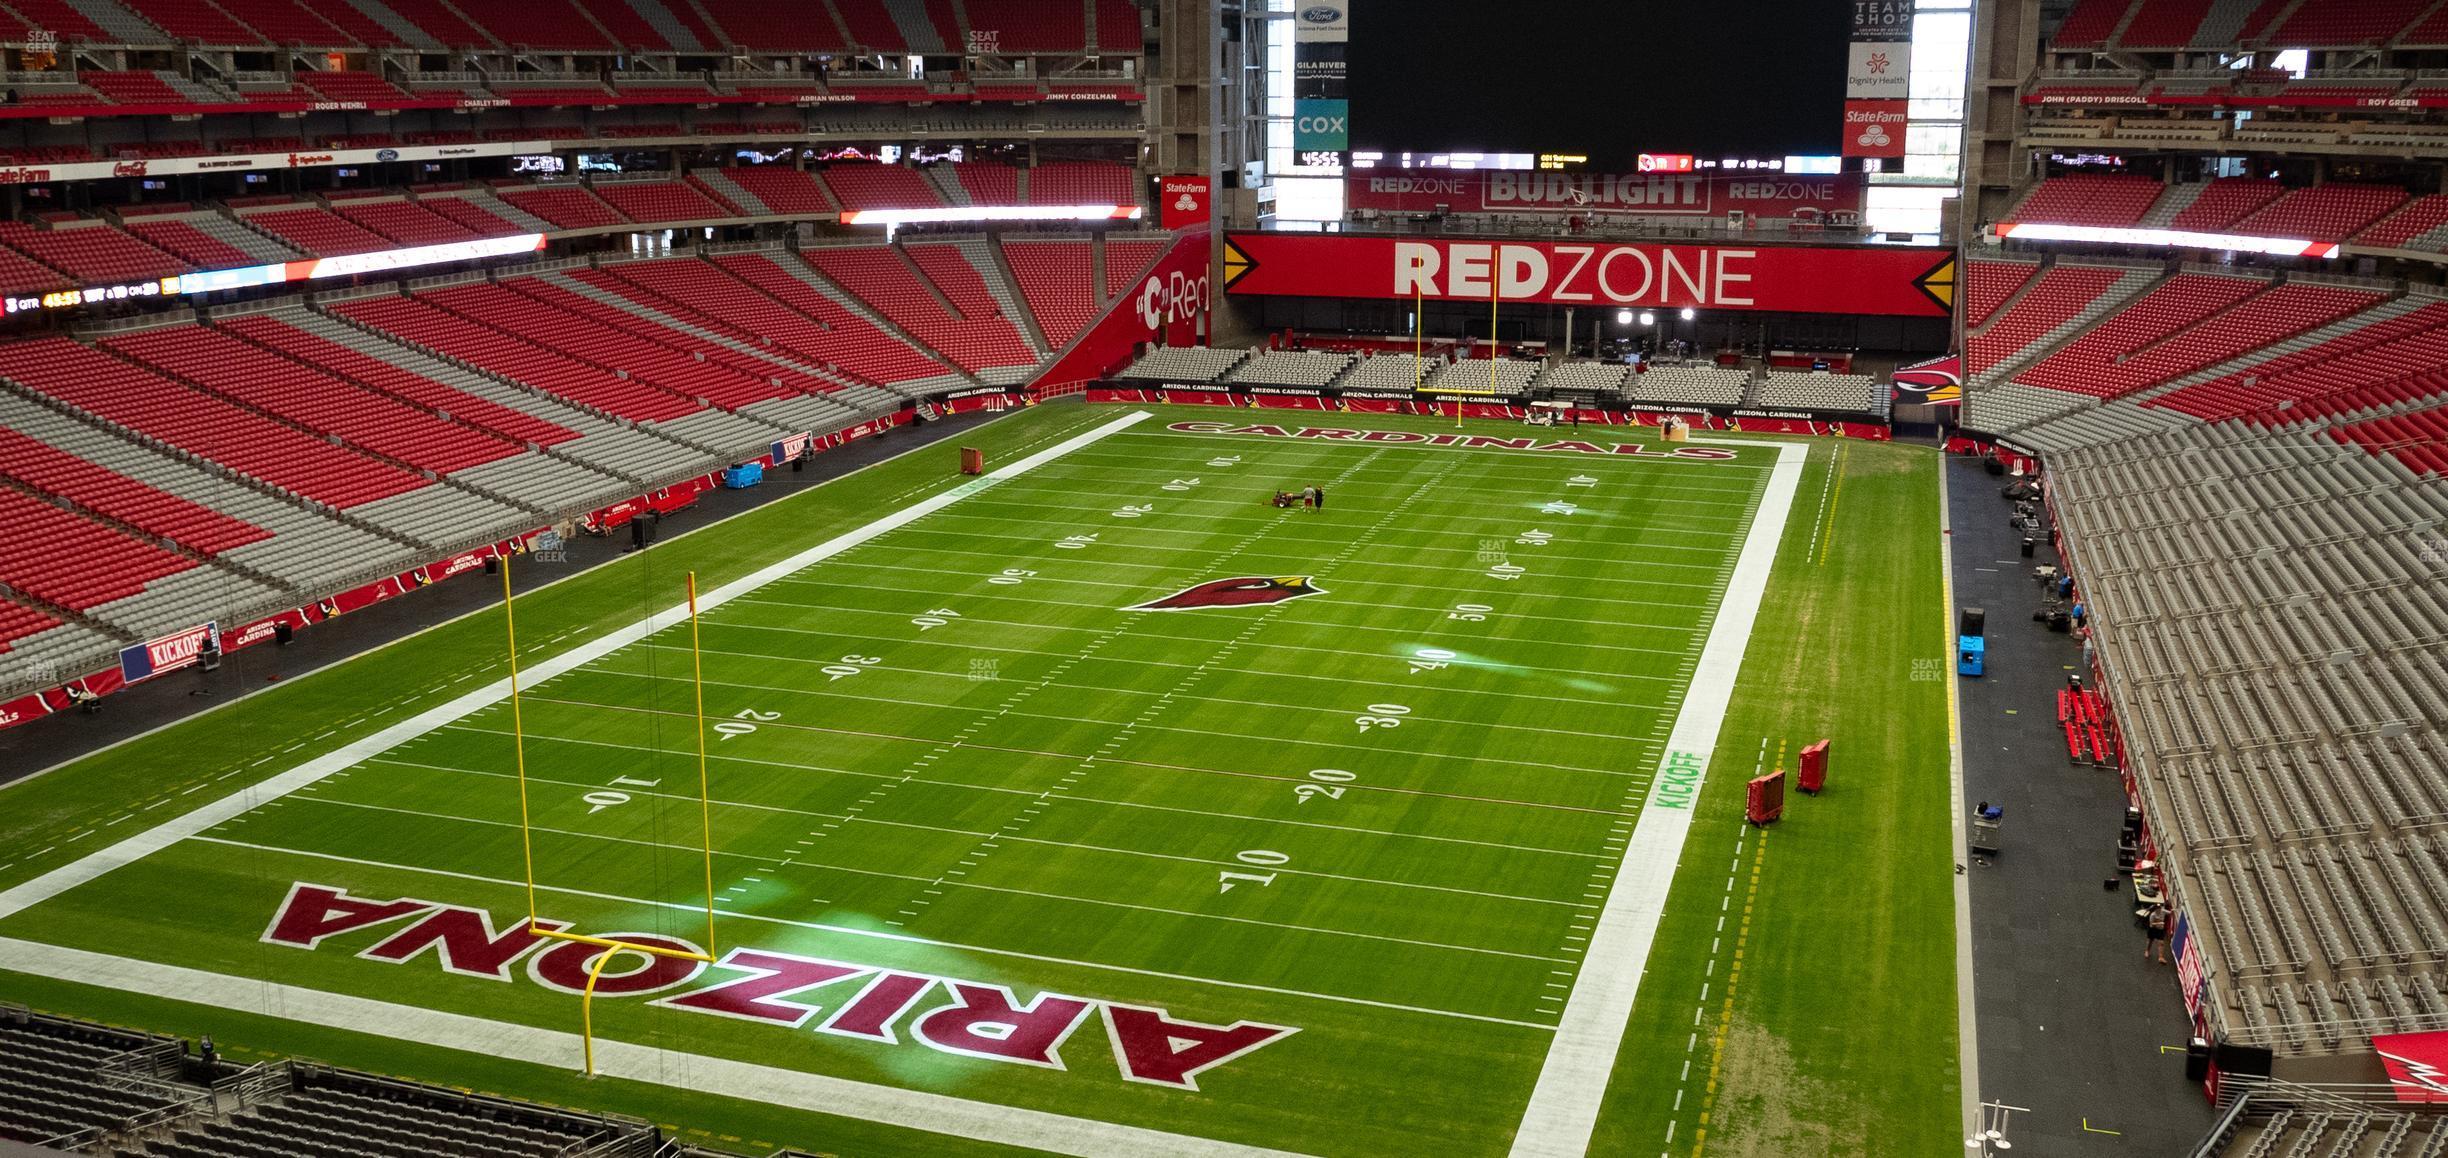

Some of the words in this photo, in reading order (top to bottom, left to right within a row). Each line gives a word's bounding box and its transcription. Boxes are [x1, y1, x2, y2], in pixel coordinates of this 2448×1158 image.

[1855, 2, 1910, 13] TEAM
[1855, 14, 1909, 25] SHOP
[1849, 76, 1877, 87] Dignity
[1878, 77, 1905, 85] Health
[315, 102, 339, 110] ROGER
[2066, 96, 2103, 104] (PADDY)
[2388, 99, 2419, 107] GREEN
[1299, 117, 1344, 133] COX
[1302, 151, 1340, 166] 45:55
[1370, 177, 1465, 195] REDZONE
[1490, 173, 1574, 201] BUD
[1582, 174, 1702, 205] LIGHT
[1728, 182, 1835, 200] REDZONE
[1394, 242, 1756, 306] REDZONE
[948, 390, 972, 399] ARIZONA
[972, 386, 1006, 396] CARDINALS
[1162, 383, 1191, 391] ARIZONA
[1341, 391, 1372, 399] ARIZONA
[1468, 397, 1509, 405] CARDINALS
[1631, 404, 1664, 412] ARIZONA
[1733, 409, 1767, 417] ARIZONA
[1167, 421, 1738, 461] CARDINALS
[445, 557, 482, 574] CARDINALS
[246, 620, 275, 635] ARIZONA
[237, 626, 275, 646] CARDINA
[820, 654, 882, 676] 30
[713, 708, 782, 735] 20
[1355, 703, 1411, 729] 30
[1294, 768, 1357, 800] 20
[1654, 751, 1703, 809] KICKOFF
[582, 774, 661, 807] 10
[1218, 849, 1290, 887] 10
[259, 881, 1304, 1092] ARIZONA
